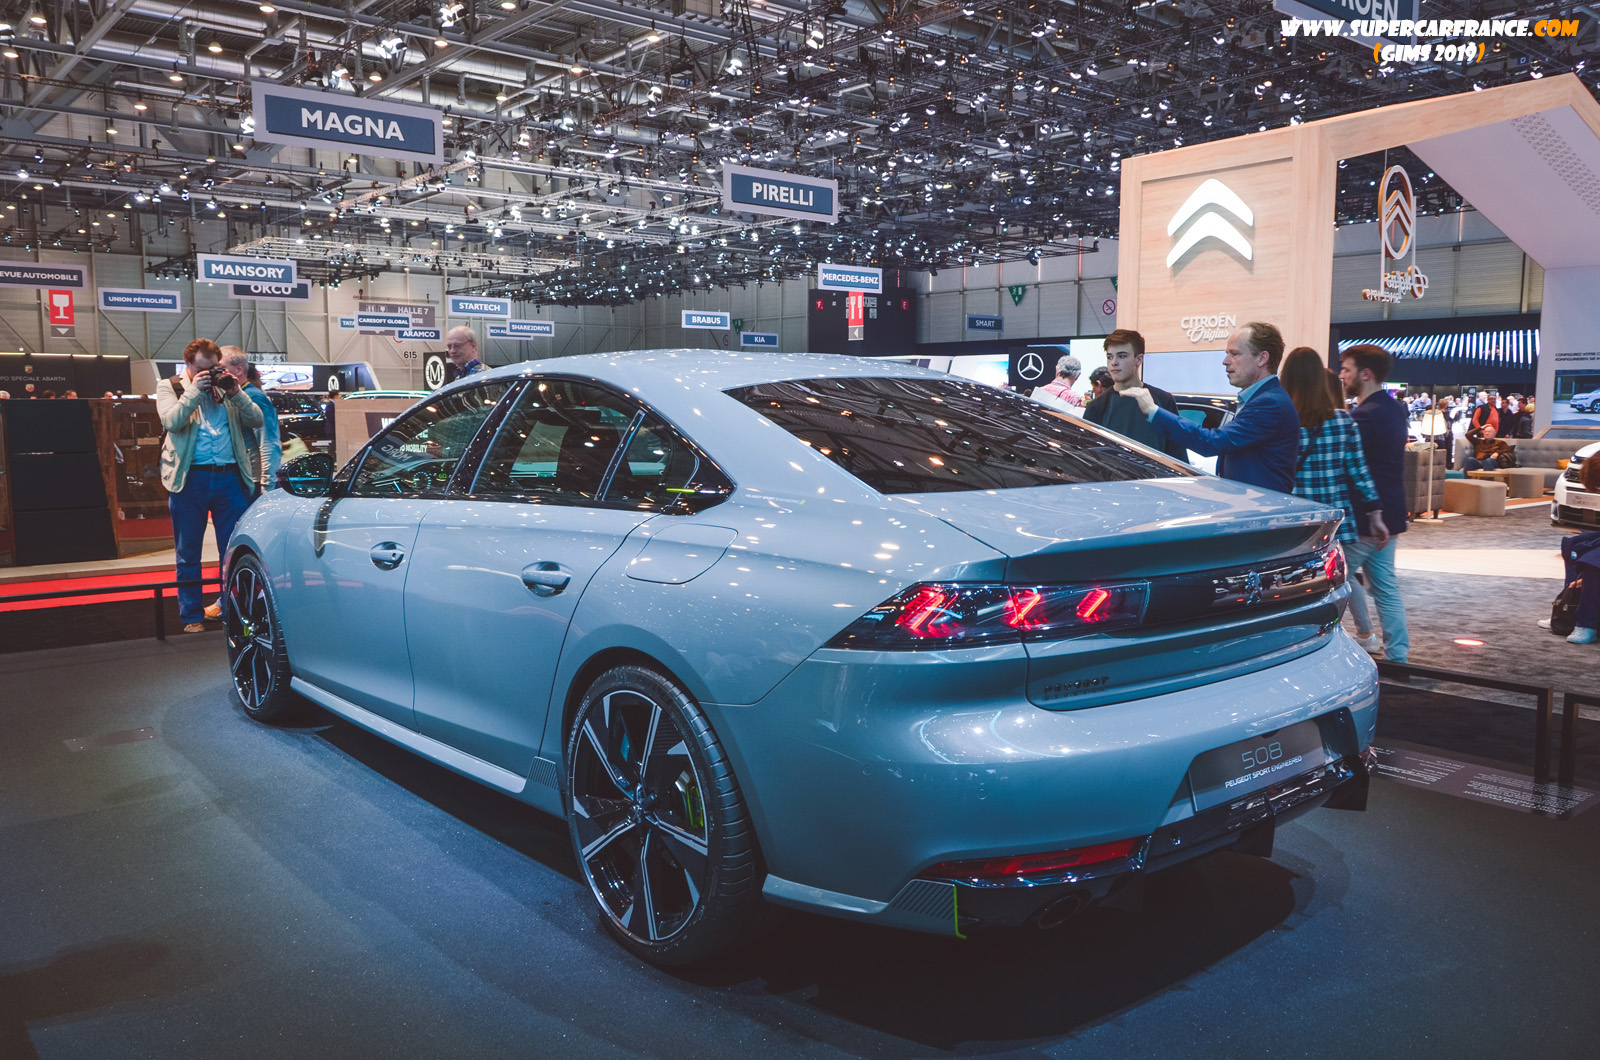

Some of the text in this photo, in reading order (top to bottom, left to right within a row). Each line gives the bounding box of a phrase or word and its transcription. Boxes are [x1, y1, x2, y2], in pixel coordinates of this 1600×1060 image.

[300, 107, 405, 142] MAGNA
[752, 181, 814, 207] PIRELLI
[0, 270, 79, 282] EVUE AUTOMOBILE
[210, 263, 286, 279] MANSORY
[822, 272, 879, 285] MERCEDES-BENZ
[108, 295, 173, 306] UNION PÉTROLIÈRE
[397, 306, 429, 315] HALLE 7
[458, 302, 501, 312] STARTECH
[358, 317, 409, 326] CARESOFT GLOBAL
[691, 315, 722, 325] BRABUS
[975, 319, 995, 328] SMART
[1180, 312, 1237, 329] CITROËN
[511, 323, 551, 333] SHARE2DRIVE
[402, 330, 436, 338] ARAMCO
[1186, 325, 1230, 343] Origins
[403, 351, 418, 359] 615
[1241, 741, 1283, 770] 508
[1225, 755, 1303, 789] PEUGEOT SPORT ENGINEERED
